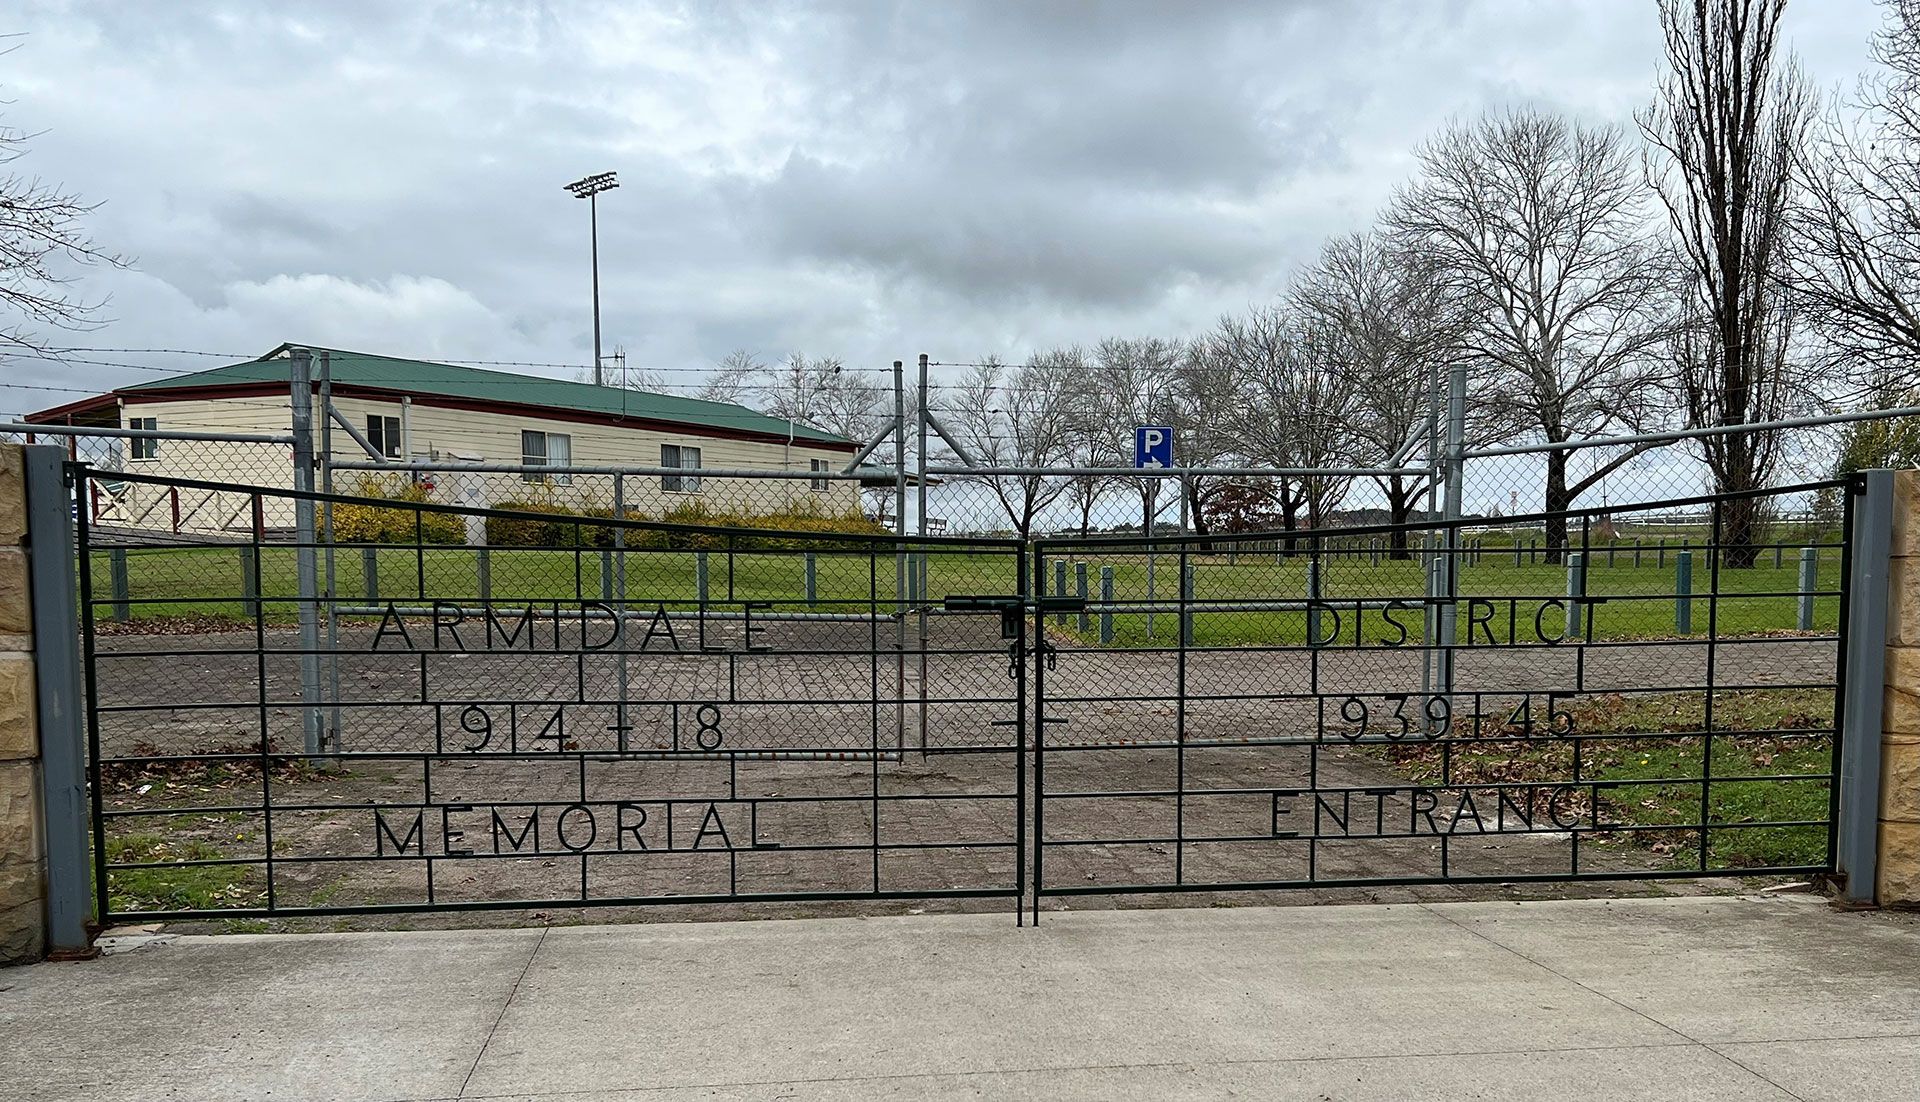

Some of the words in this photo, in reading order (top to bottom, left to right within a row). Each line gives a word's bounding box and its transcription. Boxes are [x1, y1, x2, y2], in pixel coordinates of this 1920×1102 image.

[1144, 429, 1163, 454] P
[372, 601, 774, 651] ARMIDALE
[1306, 598, 1607, 648] DISTRICT
[374, 803, 780, 857] MEMORIAL
[1271, 785, 1619, 837] ENTRANCE
